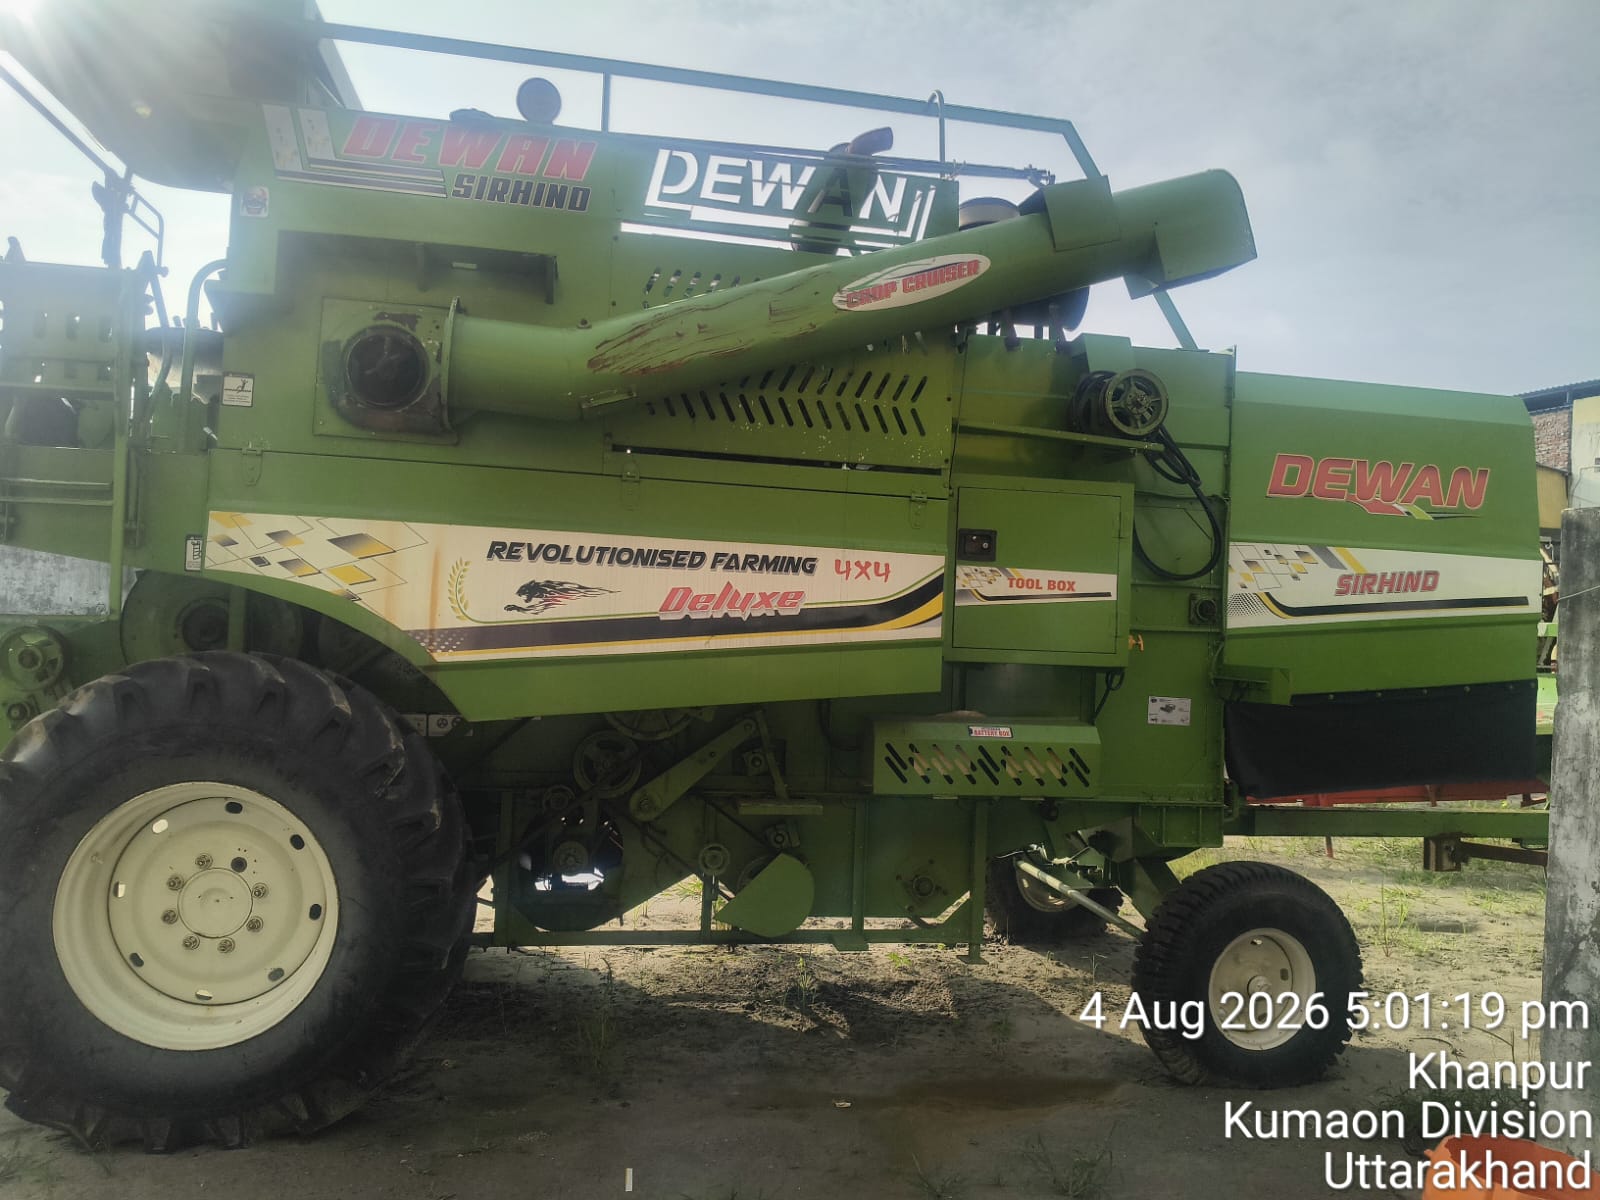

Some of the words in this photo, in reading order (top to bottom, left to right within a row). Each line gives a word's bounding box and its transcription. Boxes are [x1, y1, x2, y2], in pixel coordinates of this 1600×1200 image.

[343, 115, 597, 182] DEWAN
[451, 173, 592, 212] SIRHIND
[644, 148, 908, 224] DEWAN
[846, 280, 898, 309] CROP
[902, 259, 980, 294] CRUISER
[1266, 453, 1490, 510] DEWAN
[486, 540, 706, 571] REVOLUTIONISED
[710, 551, 818, 576] FARMING
[658, 581, 805, 622] Deluxe
[1007, 577, 1043, 591] TOOL
[1047, 580, 1077, 592] BOX
[1334, 570, 1441, 597] SIRHIND
[974, 729, 997, 737] BATTERY
